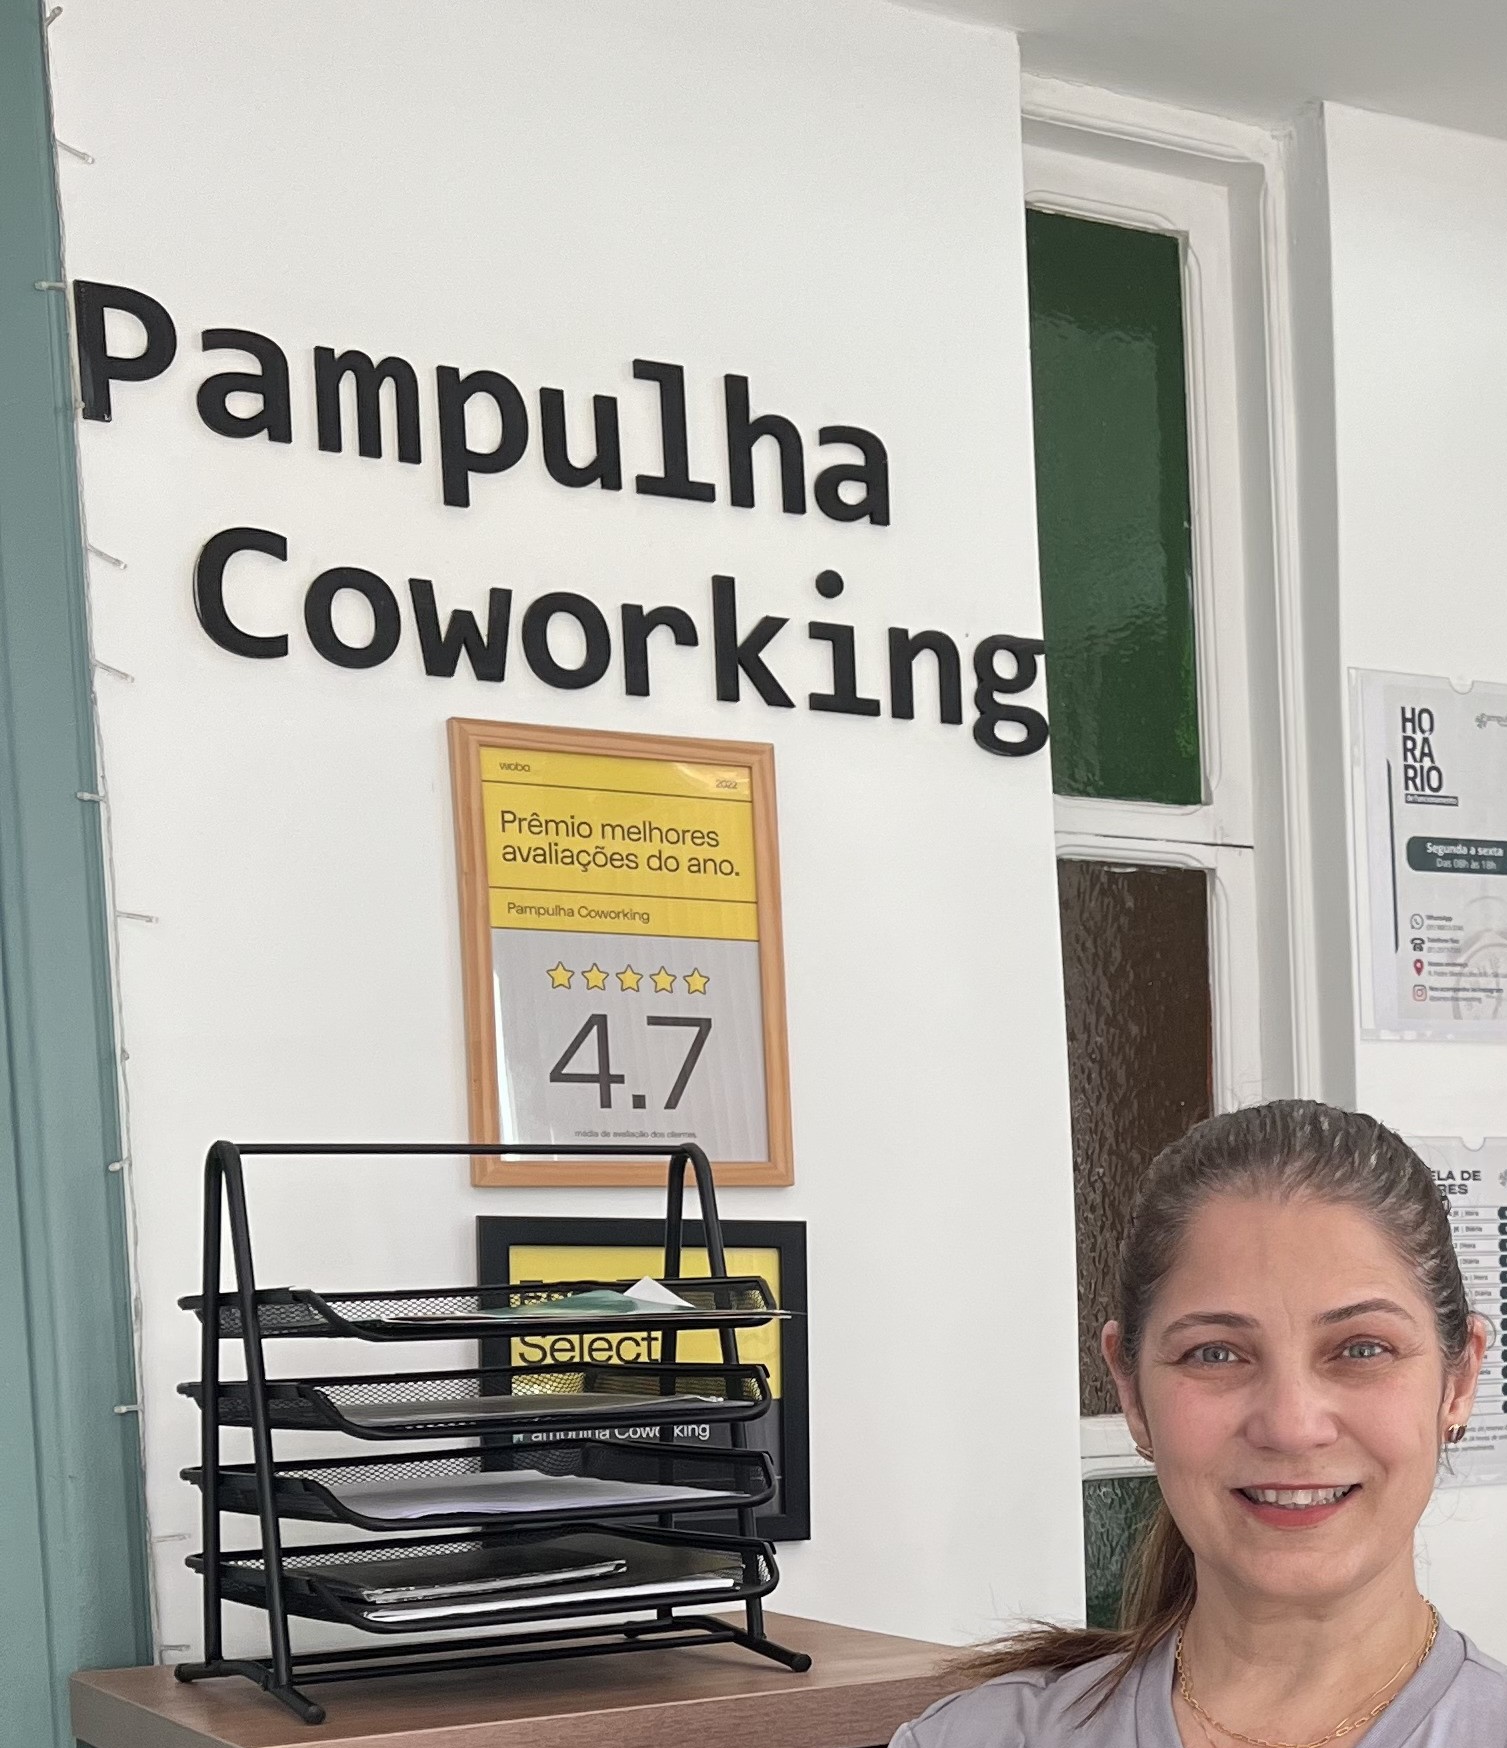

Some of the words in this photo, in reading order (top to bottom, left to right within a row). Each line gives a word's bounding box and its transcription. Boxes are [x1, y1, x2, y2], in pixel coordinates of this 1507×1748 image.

[73, 278, 891, 528] Pampulha
[192, 525, 1050, 758] Coworking
[1401, 706, 1435, 735] HO
[498, 761, 531, 773] woba
[1403, 763, 1444, 793] RIO
[500, 809, 593, 839] Prêmio
[600, 820, 720, 848] melhores
[501, 842, 640, 873] avaliações
[646, 849, 680, 873] do
[687, 857, 741, 877] ano.
[1425, 842, 1468, 856] Segunda
[1469, 846, 1476, 855] a
[1477, 847, 1504, 857] sexta
[506, 901, 575, 918] Pampulha
[577, 905, 651, 925] Coworking
[548, 1011, 713, 1110] 4.7
[1460, 1170, 1482, 1181] DE
[518, 1331, 660, 1364] Select
[614, 1423, 710, 1441] Cowking
